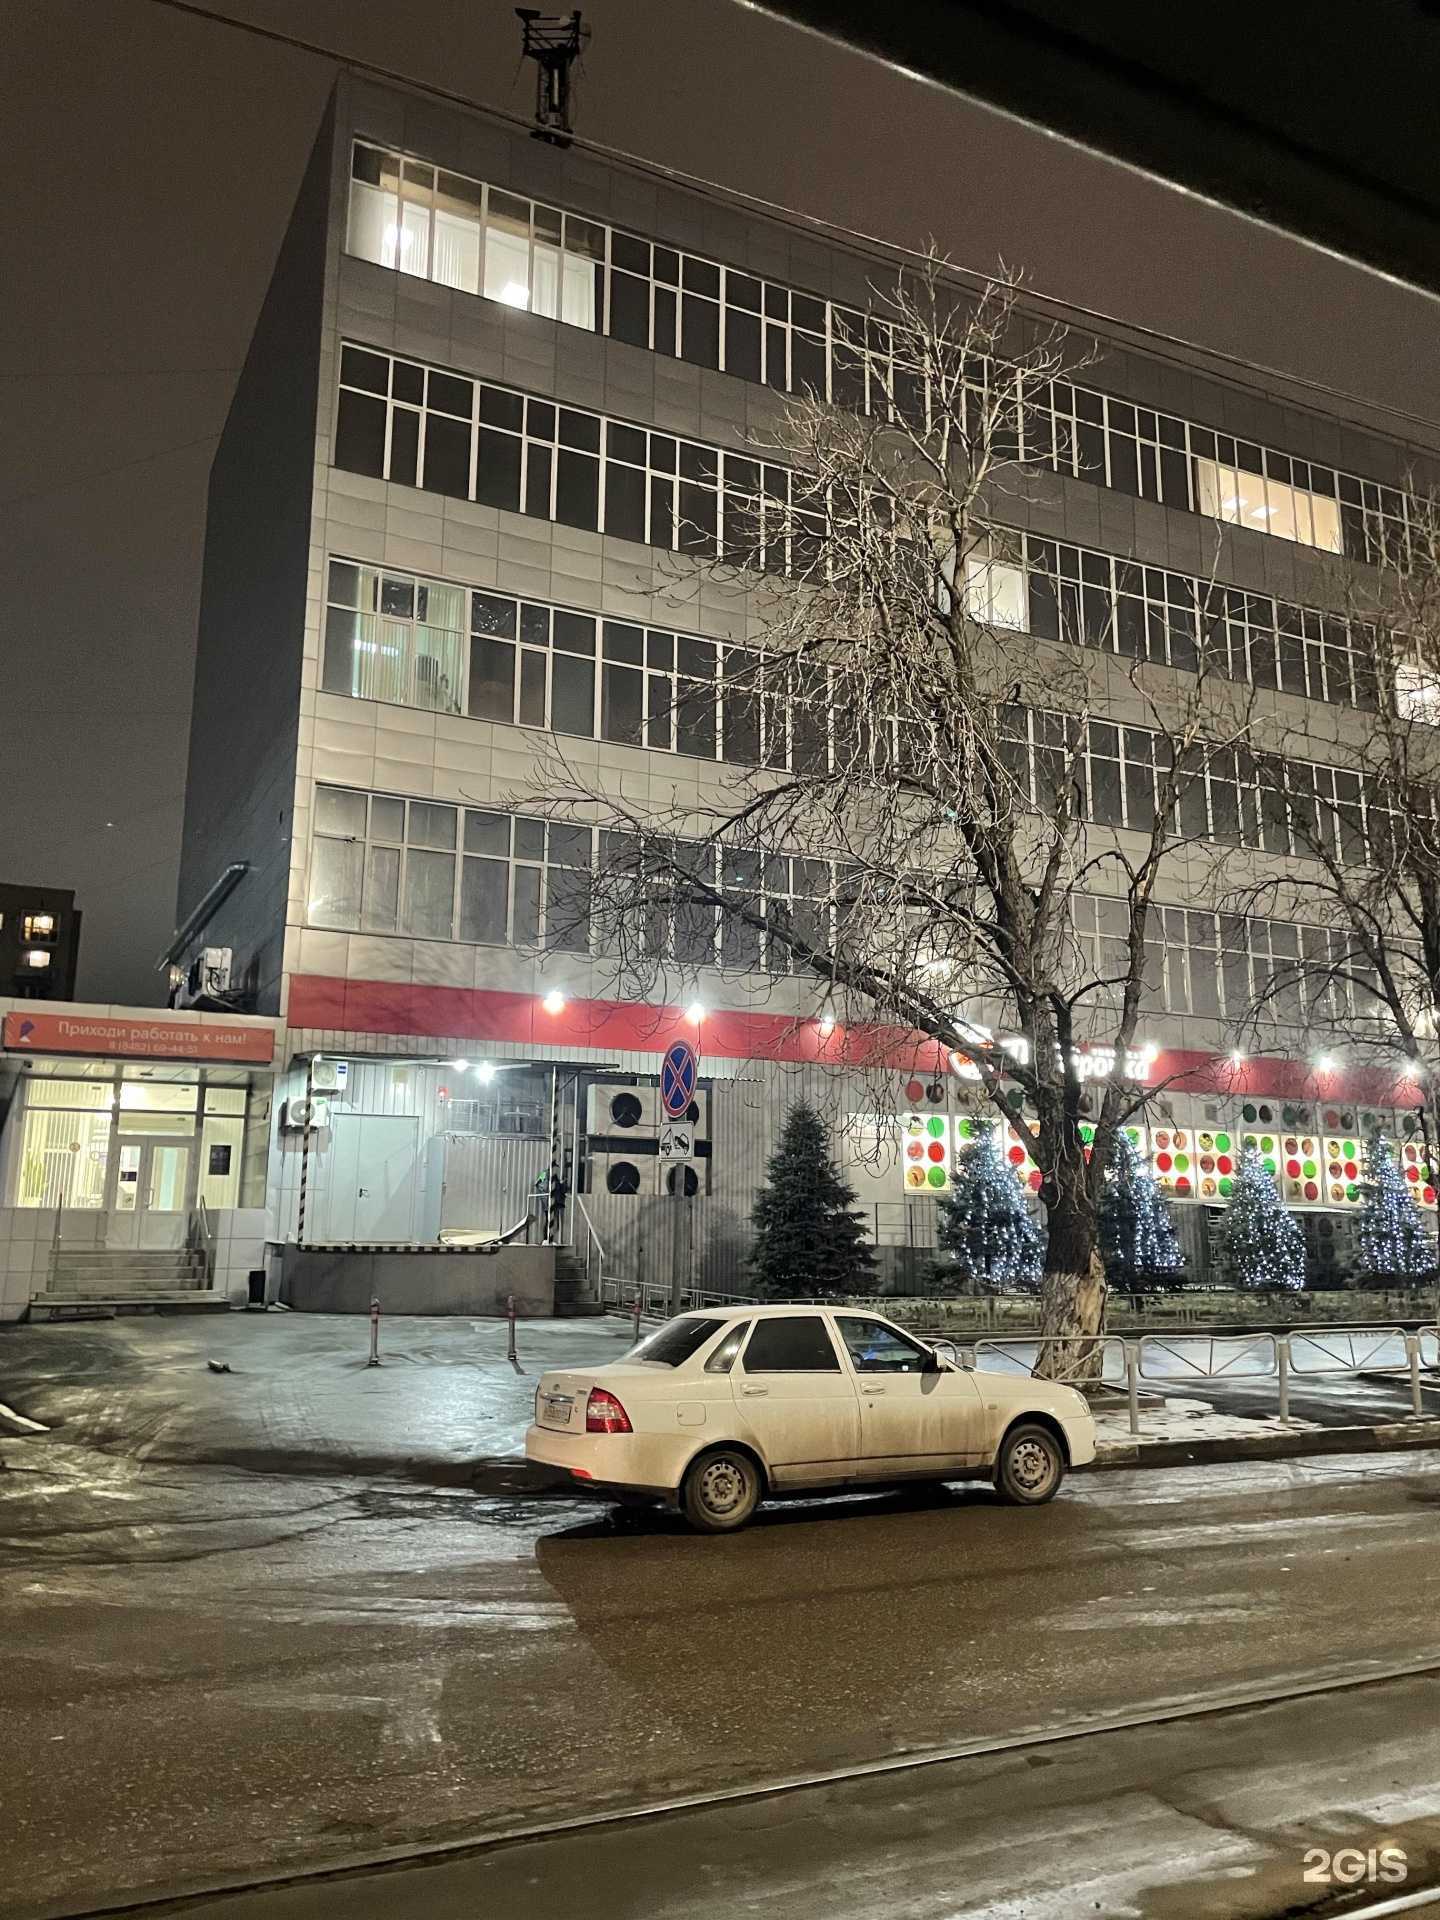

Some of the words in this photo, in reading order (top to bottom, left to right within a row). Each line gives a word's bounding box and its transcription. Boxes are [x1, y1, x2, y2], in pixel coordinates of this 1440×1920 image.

[58, 1020, 126, 1038] Приходи
[130, 1026, 198, 1042] работать
[202, 1034, 211, 1043] к
[215, 1033, 248, 1045] нам!
